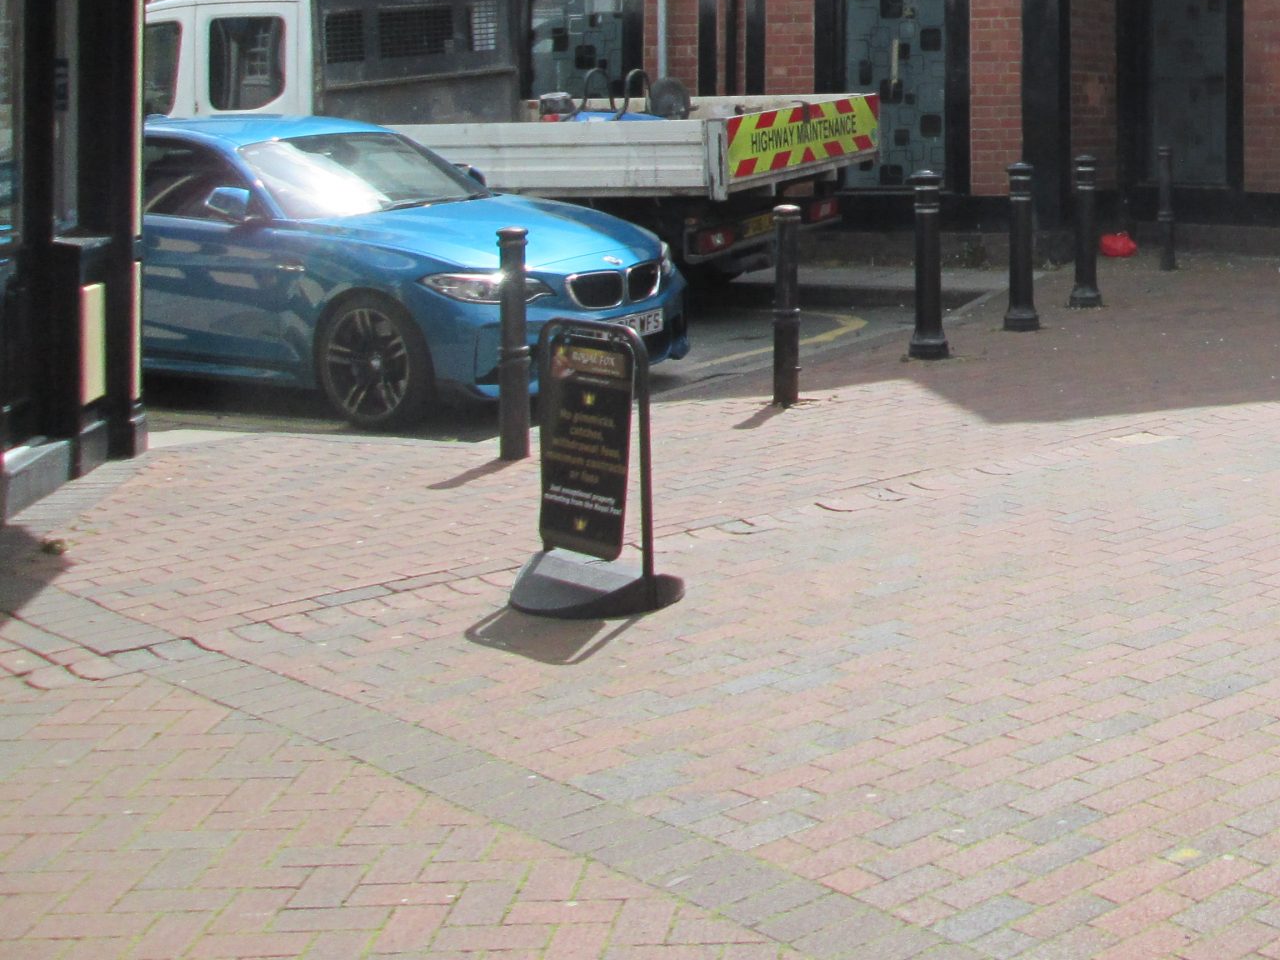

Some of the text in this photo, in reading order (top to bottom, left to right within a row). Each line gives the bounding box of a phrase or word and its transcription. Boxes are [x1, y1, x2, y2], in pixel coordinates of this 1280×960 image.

[751, 114, 858, 154] HIGHWAY MAINTENANCE
[599, 354, 616, 367] FOX
